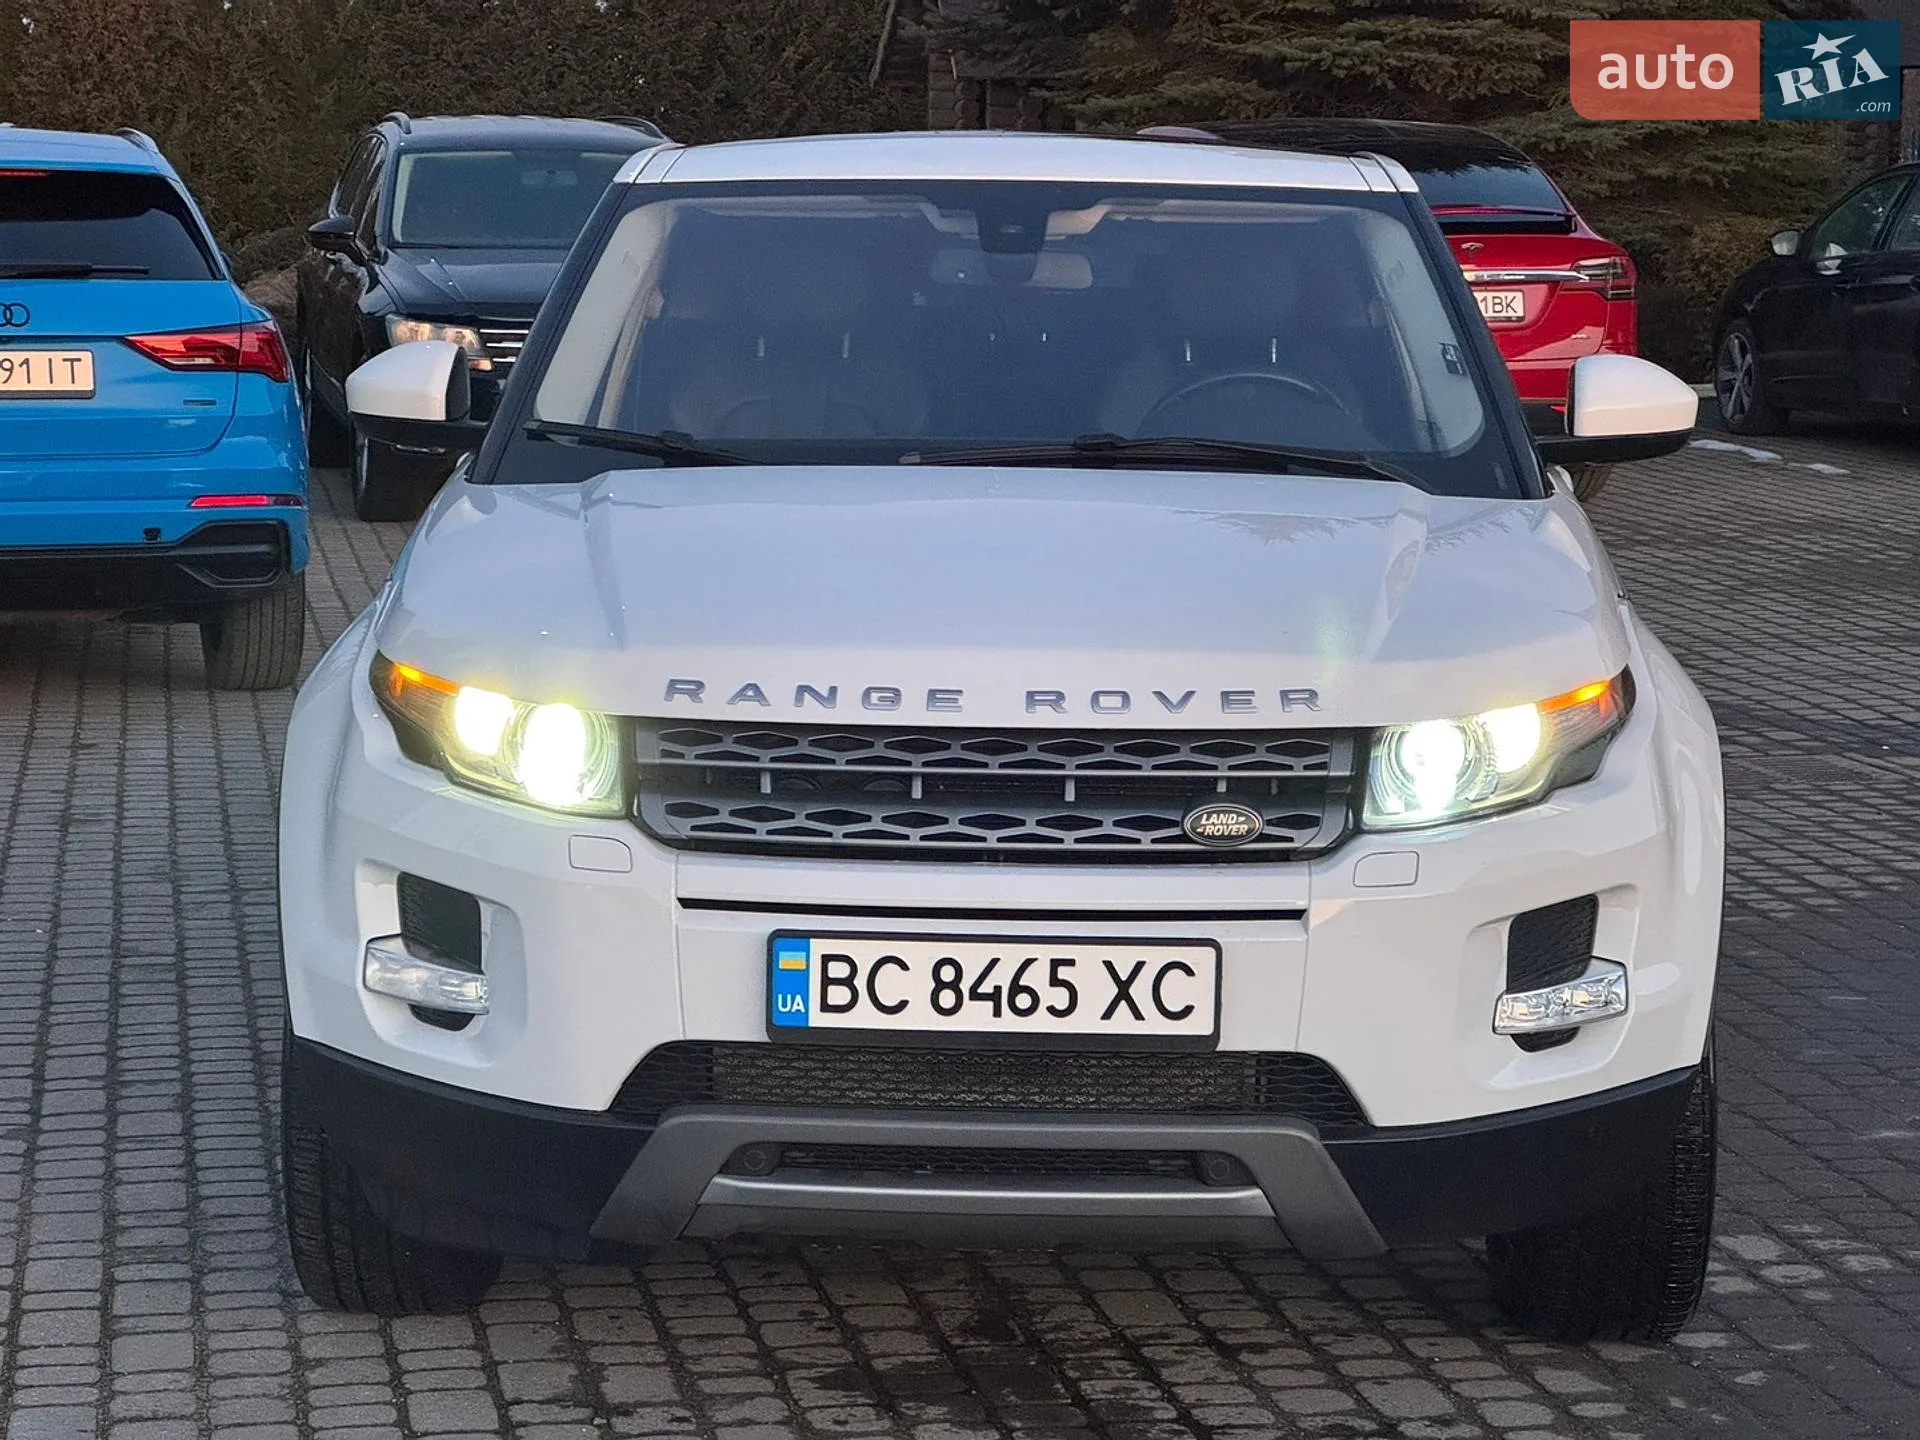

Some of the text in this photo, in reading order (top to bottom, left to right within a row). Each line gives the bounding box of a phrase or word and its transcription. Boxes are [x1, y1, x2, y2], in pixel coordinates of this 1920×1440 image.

[663, 678, 1321, 714] RANGE ROVER
[1200, 813, 1237, 825] LAND
[1204, 825, 1249, 836] ROVER
[819, 953, 1196, 1021] BC 8465 XC
[777, 994, 806, 1013] UA
